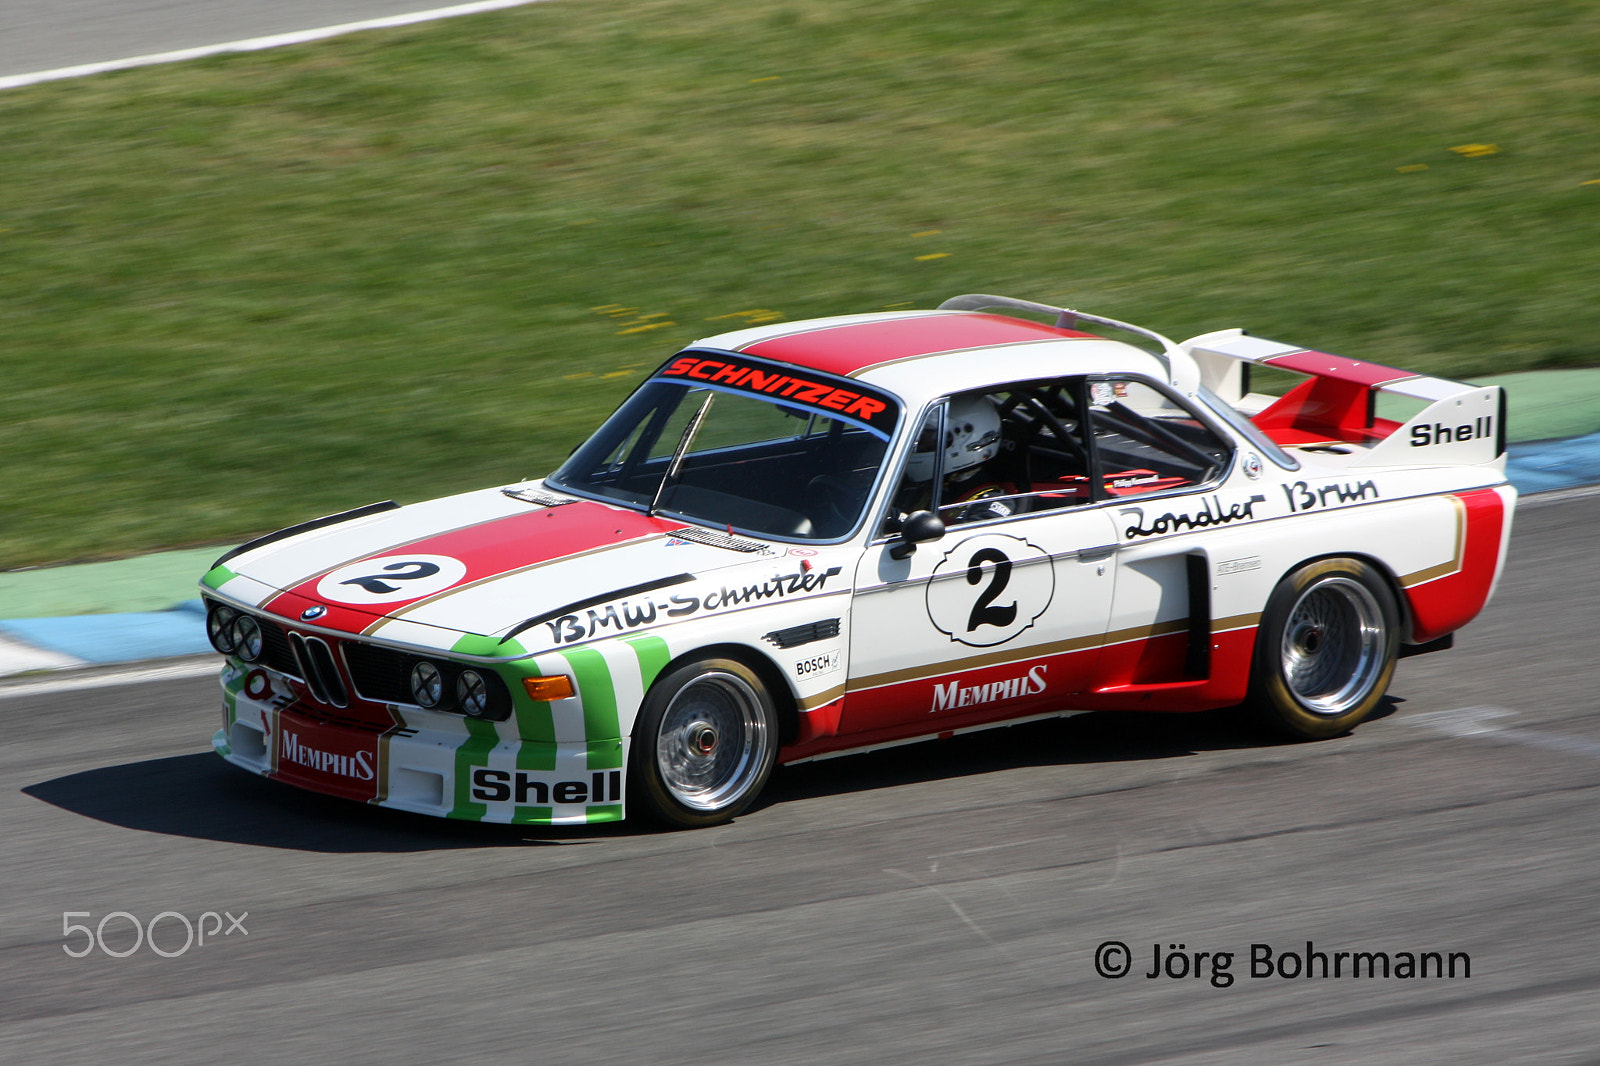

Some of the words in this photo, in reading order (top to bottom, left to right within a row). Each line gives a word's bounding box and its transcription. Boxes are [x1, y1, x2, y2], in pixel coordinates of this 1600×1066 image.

[662, 357, 887, 420] SCHNITZER
[1410, 416, 1492, 447] Shell
[1281, 479, 1380, 513] Brun
[338, 561, 441, 594] 2
[966, 547, 1017, 632] 2
[545, 566, 843, 644] BMW-Schnitzer
[796, 654, 830, 676] BOSCH
[929, 664, 1047, 713] MEMPHIS
[281, 729, 374, 780] MEMPHIS
[472, 769, 621, 804] Shell
